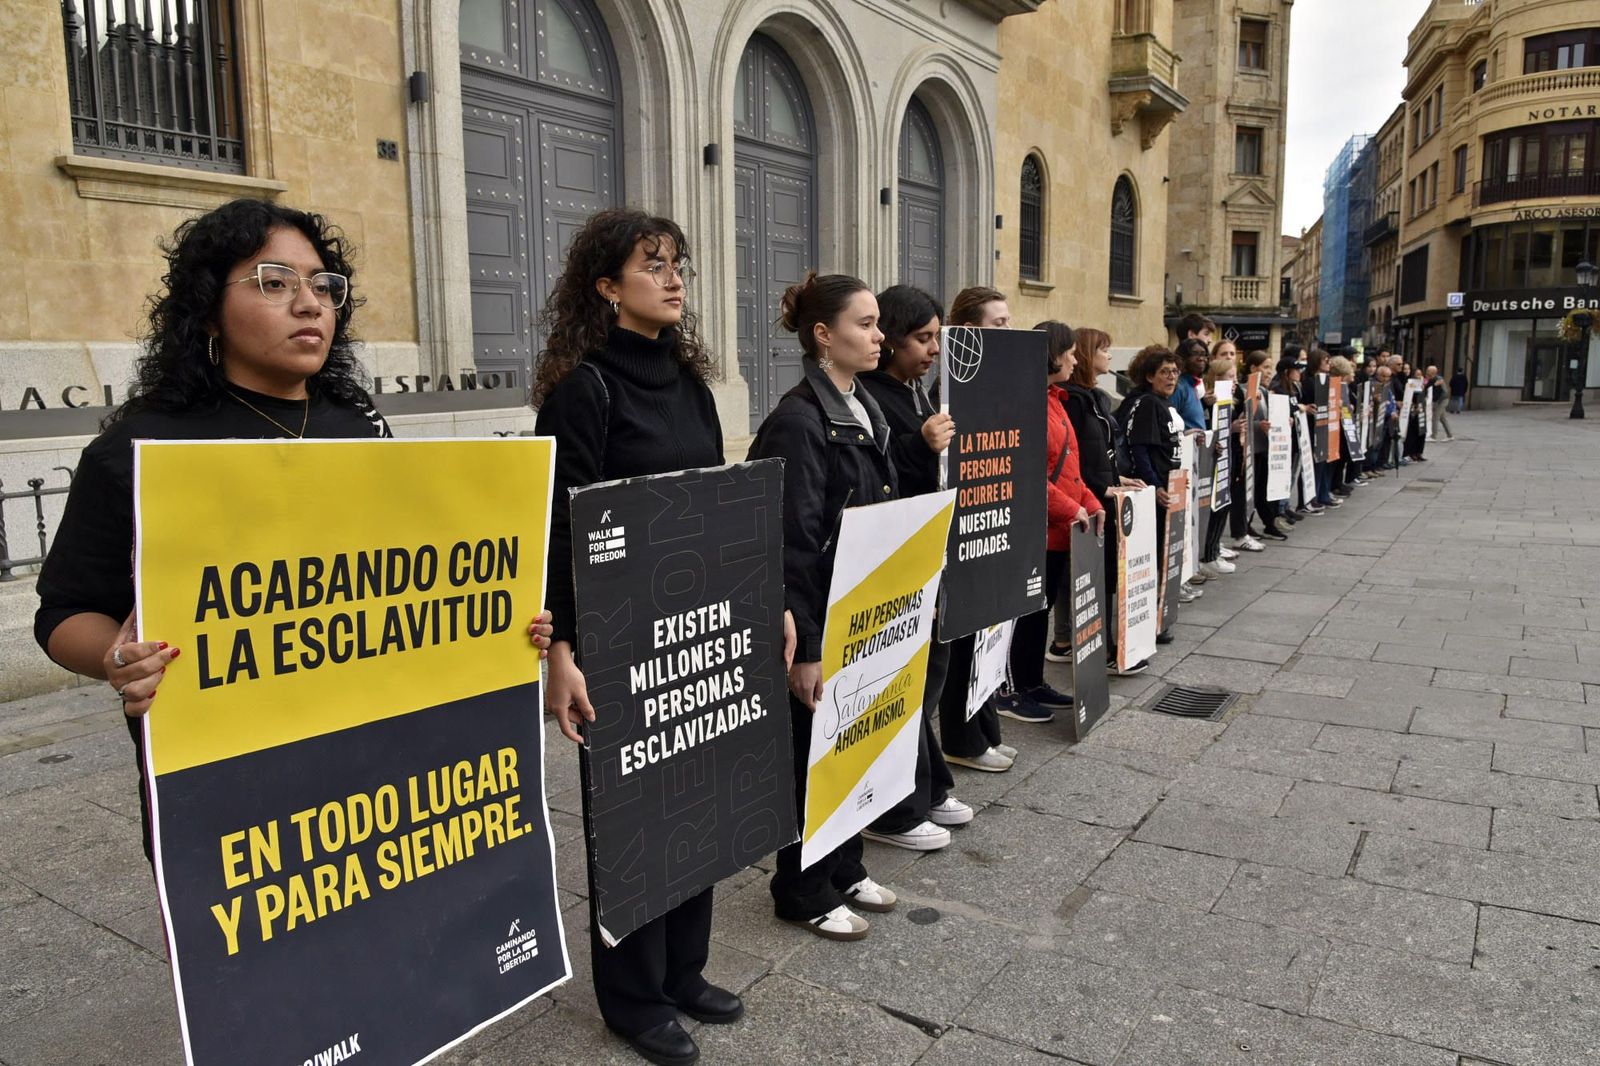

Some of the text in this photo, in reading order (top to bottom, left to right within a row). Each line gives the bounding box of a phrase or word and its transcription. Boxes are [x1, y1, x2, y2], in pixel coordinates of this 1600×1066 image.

[1528, 105, 1597, 121] NOTAR
[1515, 208, 1552, 221] ARCO
[1473, 296, 1600, 312] Deutsche Ban
[960, 429, 1020, 454] LA TRATA DE
[959, 456, 1012, 481] PERSONAS
[959, 481, 1013, 508] OCURRE EN
[588, 529, 612, 541] WALK
[959, 506, 1011, 535] NUESTRAS
[589, 542, 605, 553] FOR
[589, 549, 626, 565] FREEDOM
[958, 532, 1011, 562] CIUDADES.
[195, 535, 519, 622] ACABANDO CON
[653, 600, 731, 649] EXISTEN
[848, 588, 924, 638] HAY PERSONAS
[196, 590, 513, 690] LA ESCLAVITUD
[842, 614, 921, 668] EXPLOTADAS EN
[630, 628, 752, 695] MILLONES DE
[644, 665, 745, 728] PERSONAS
[620, 693, 768, 776] ESCLAVIZADAS.
[834, 697, 907, 756] AHORA MISMO.
[220, 747, 520, 890] EN TODO LUGAR
[210, 794, 533, 956] Y PARA SIEMPRE.
[495, 929, 536, 955] CAMINANDO
[497, 946, 522, 965] POR LA
[499, 952, 531, 975] LIBERTAD
